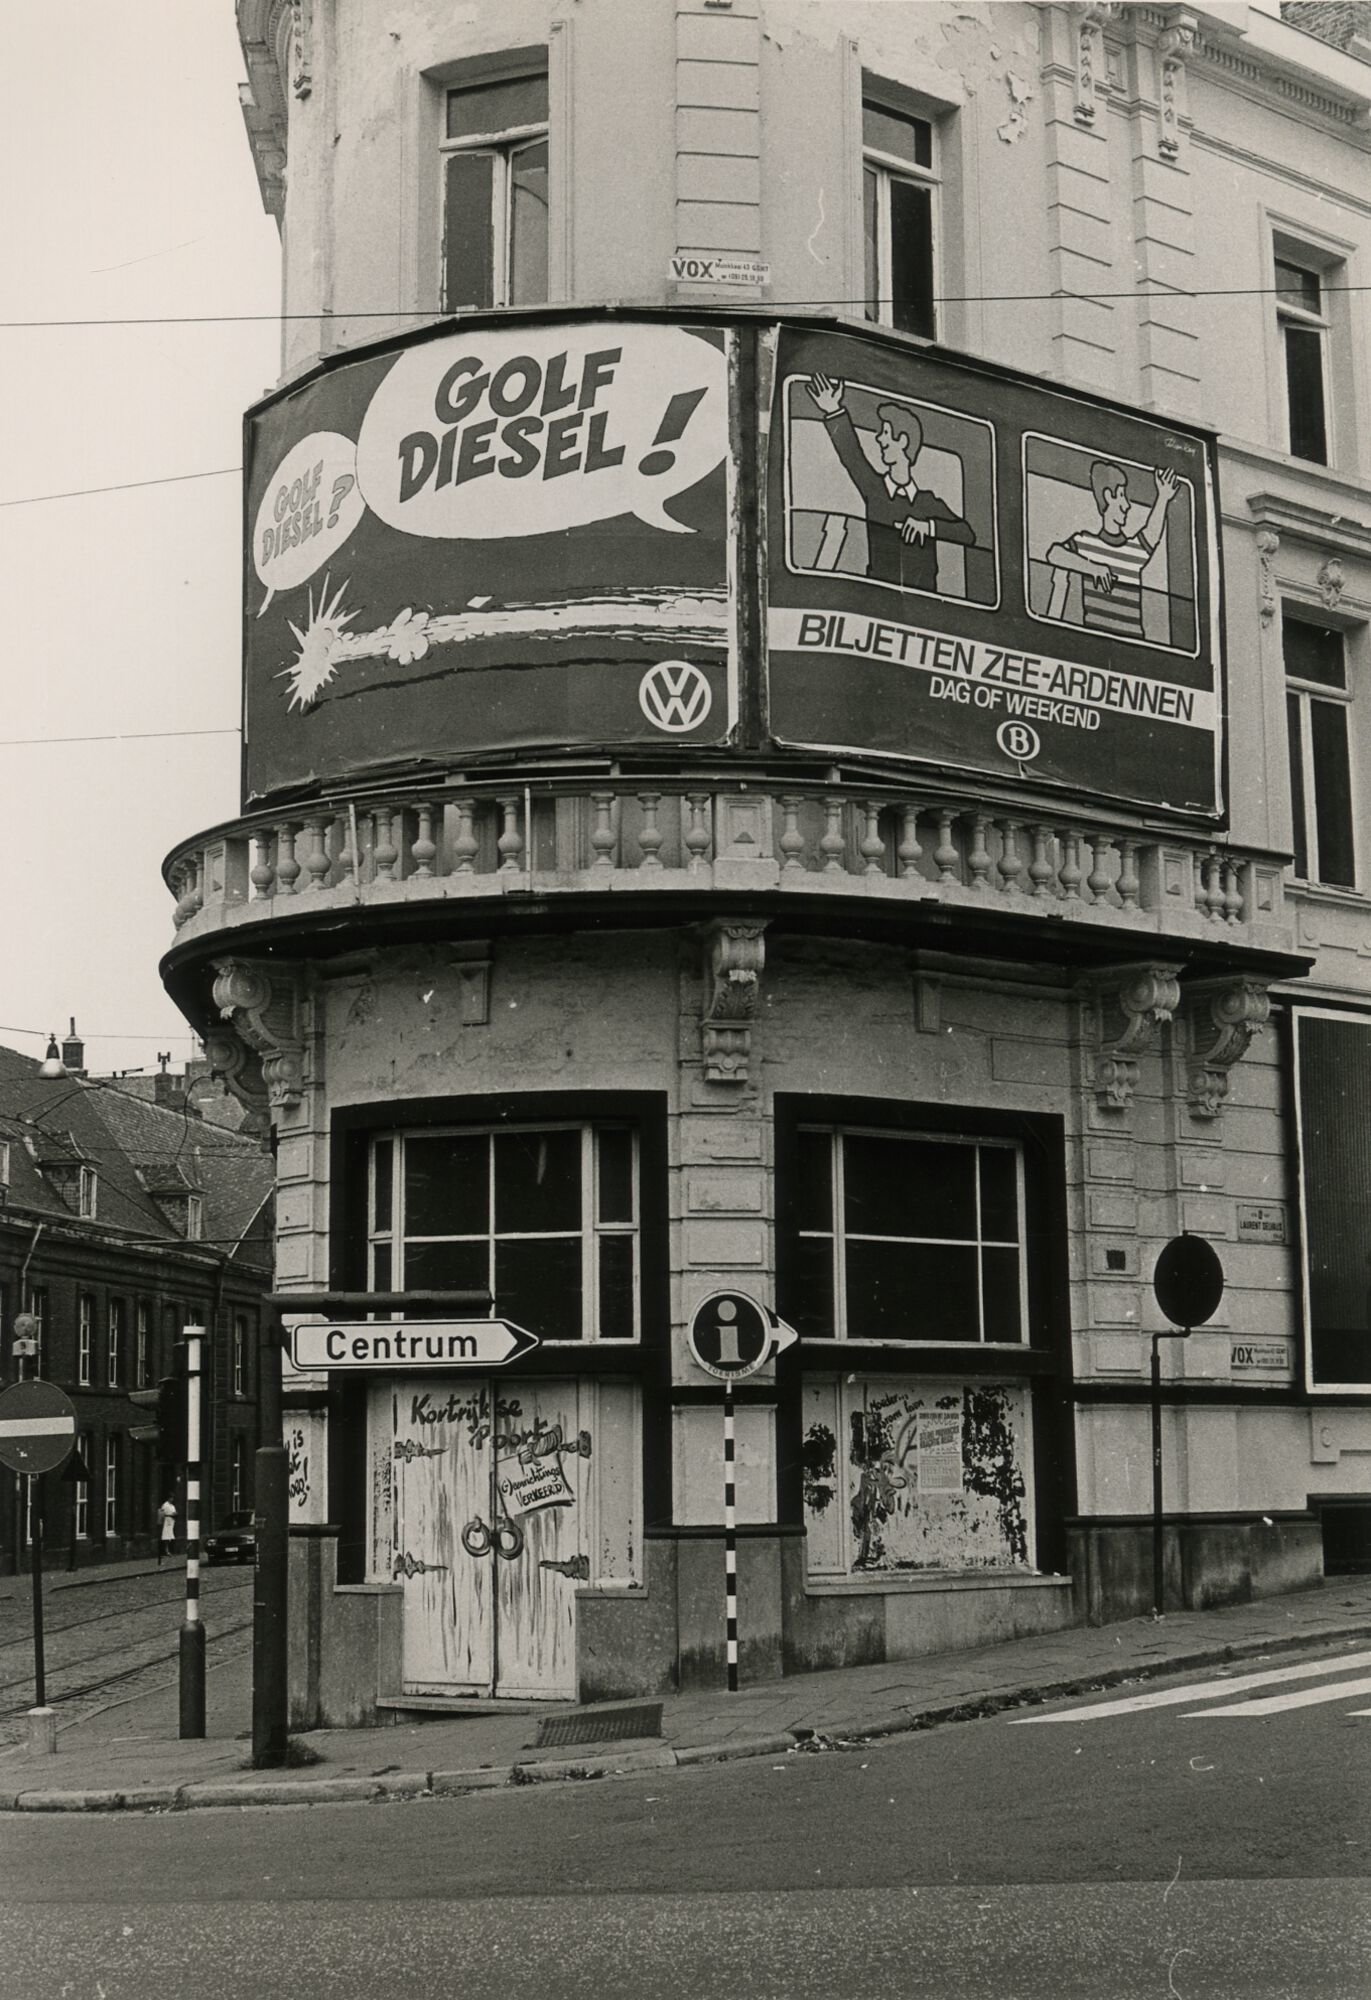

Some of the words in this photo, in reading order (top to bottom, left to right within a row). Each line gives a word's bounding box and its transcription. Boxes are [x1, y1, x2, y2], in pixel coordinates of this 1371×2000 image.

[672, 260, 713, 279] VOX
[435, 347, 623, 424] GOLF
[399, 411, 626, 503] DIESEL
[274, 459, 324, 523] GOLF
[261, 501, 324, 567] DIESEL
[798, 613, 976, 675] BILJETTEN
[981, 647, 1194, 721] ZEE-ARDENNEN
[929, 676, 970, 704] DAG
[974, 686, 1003, 709] OF
[1006, 692, 1101, 731] WEEKEND
[1008, 726, 1031, 754] B
[1240, 1220, 1262, 1231] LAURENT
[326, 1330, 478, 1360] Centrum
[411, 1388, 523, 1433] Kortrijkse
[468, 1416, 548, 1450] Poort
[293, 1429, 304, 1450] is
